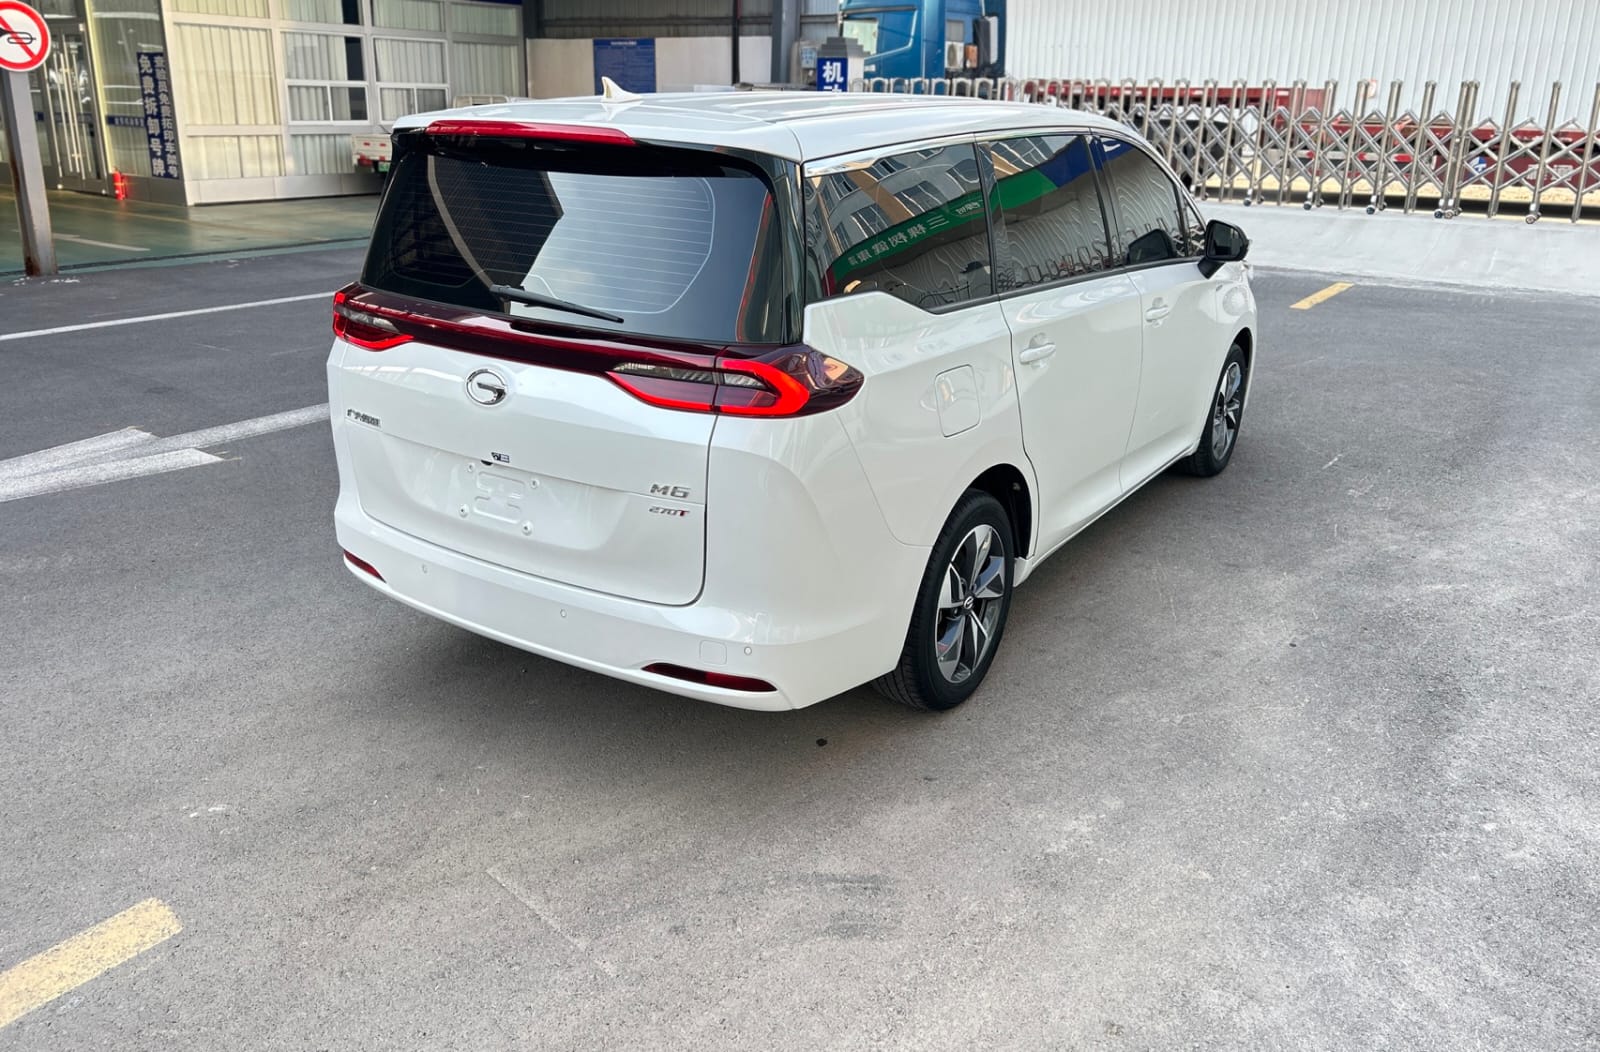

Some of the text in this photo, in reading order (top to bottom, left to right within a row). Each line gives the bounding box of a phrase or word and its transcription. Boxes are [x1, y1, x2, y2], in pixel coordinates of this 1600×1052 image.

[140, 55, 165, 176] 免费拆卸号牌
[650, 484, 691, 498] M6
[649, 506, 690, 517] 270T
